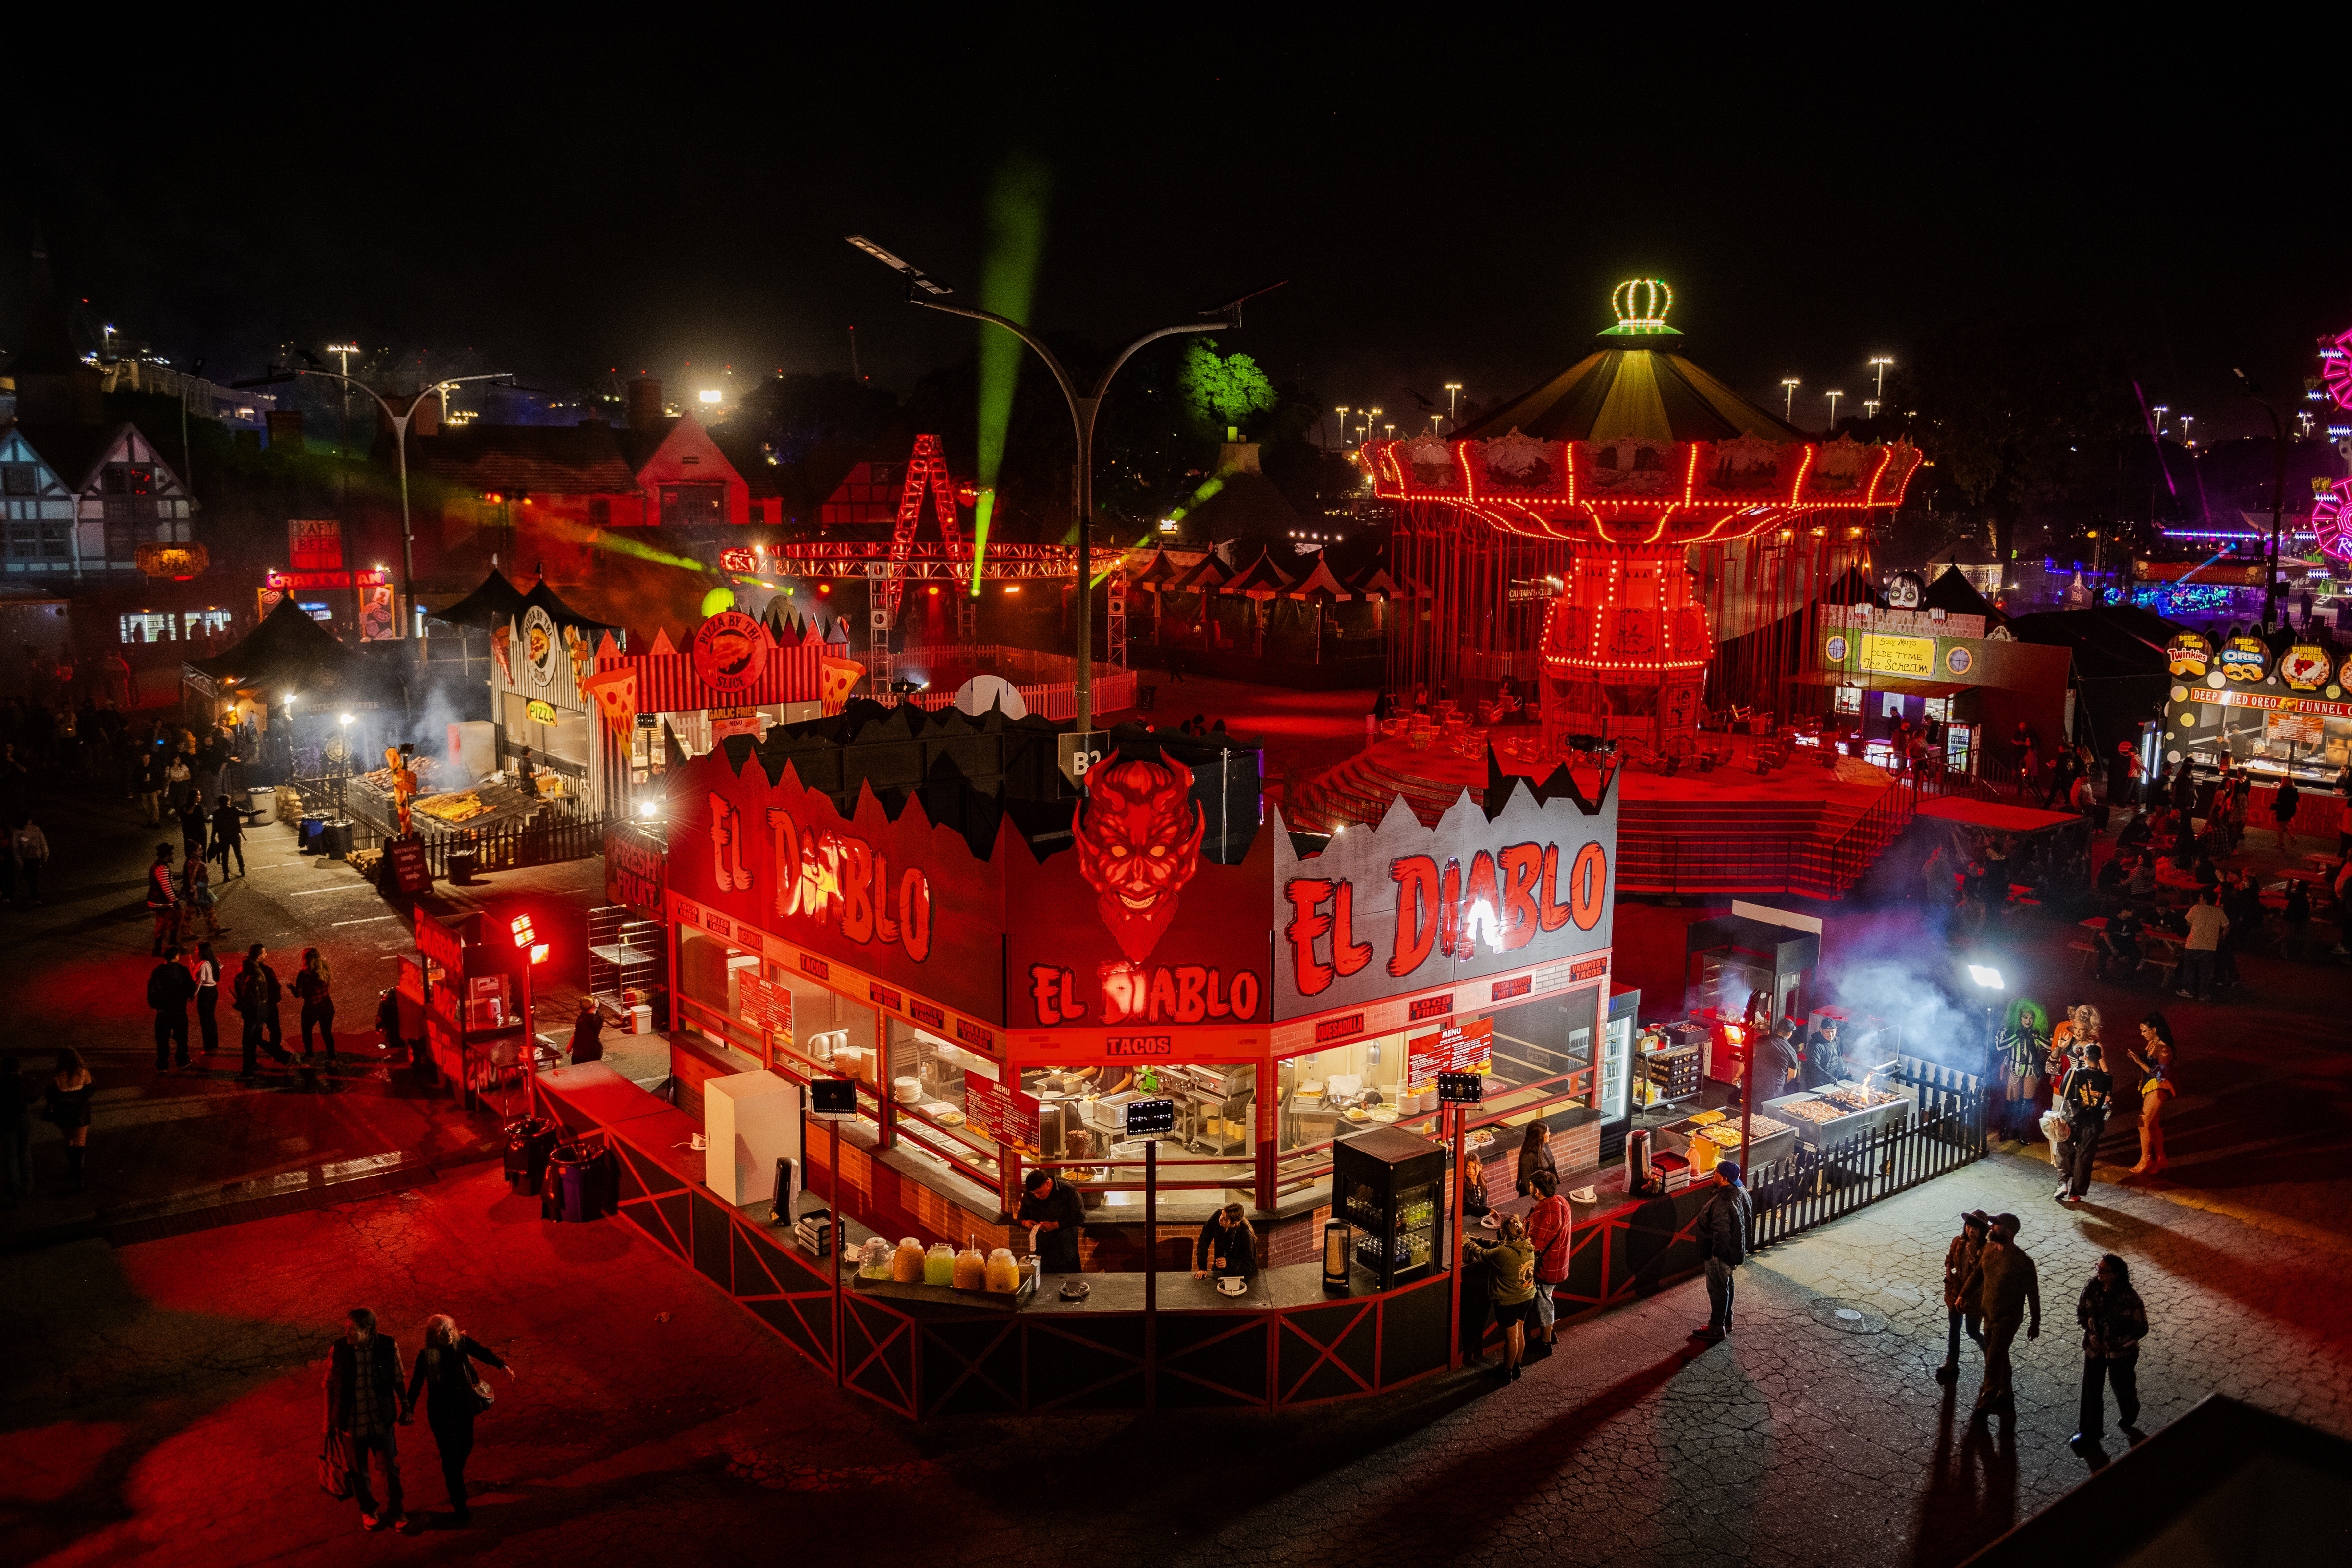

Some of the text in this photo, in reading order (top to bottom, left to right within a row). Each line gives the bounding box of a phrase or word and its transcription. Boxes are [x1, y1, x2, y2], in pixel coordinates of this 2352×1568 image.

[293, 522, 334, 535] RAFT
[300, 539, 333, 550] BEER
[159, 560, 189, 571] SODA
[270, 574, 340, 588] CRAFTY
[1509, 588, 1552, 598] CAPTAIN'S CLUB
[698, 615, 761, 645] PIZZA BY THE
[1898, 639, 1917, 648] Mary's
[2292, 646, 2323, 655] FUNNEL
[1896, 652, 1923, 661] TYME
[2168, 648, 2207, 662] Twinkies
[2223, 651, 2263, 662] OREO
[2299, 653, 2323, 662] CAKES
[1884, 659, 1929, 673] Scream
[716, 675, 746, 689] SLICE
[2194, 689, 2218, 702] DEEP
[2251, 696, 2277, 708] OREO
[530, 703, 554, 724] PIZZA
[708, 705, 757, 720] GARLIC FRIES
[2299, 701, 2342, 715] FUNNEL
[394, 845, 420, 854] RESTROOMS
[613, 837, 658, 882] FRESH
[708, 789, 932, 964] EL DIABLO
[617, 868, 657, 909] FRUIT
[678, 902, 698, 915] LOCO
[679, 909, 697, 922] FRIES
[707, 913, 729, 929] ROLLED
[1284, 840, 1607, 997] EL DIABLO
[709, 920, 728, 935] TACOS
[416, 922, 461, 973] CHURROS
[801, 955, 827, 979] TACOS
[1571, 958, 1607, 974] VAMPITO'S
[1575, 967, 1603, 980] TACOS
[760, 979, 772, 990] MENU
[1494, 976, 1532, 992] BACON WRAPPED
[1497, 984, 1527, 999] HOT DOGS
[871, 983, 900, 1002] BACON WRAPPED
[1029, 960, 1261, 1027] EL DIABLO
[874, 993, 898, 1009] HOT DOGS
[1412, 995, 1452, 1011] LOCO
[911, 1000, 942, 1020] VAMPITO'S
[1416, 1004, 1448, 1019] FRIES
[914, 1010, 940, 1027] TACOS
[958, 1020, 991, 1041] ROLLED
[1318, 1015, 1363, 1041] QUESADILLA
[1442, 1027, 1462, 1039] MENU
[962, 1030, 988, 1049] TACOS
[1108, 1037, 1169, 1054] TACOS
[1528, 1052, 1549, 1064] PEPSI
[993, 1082, 1010, 1096] MENU
